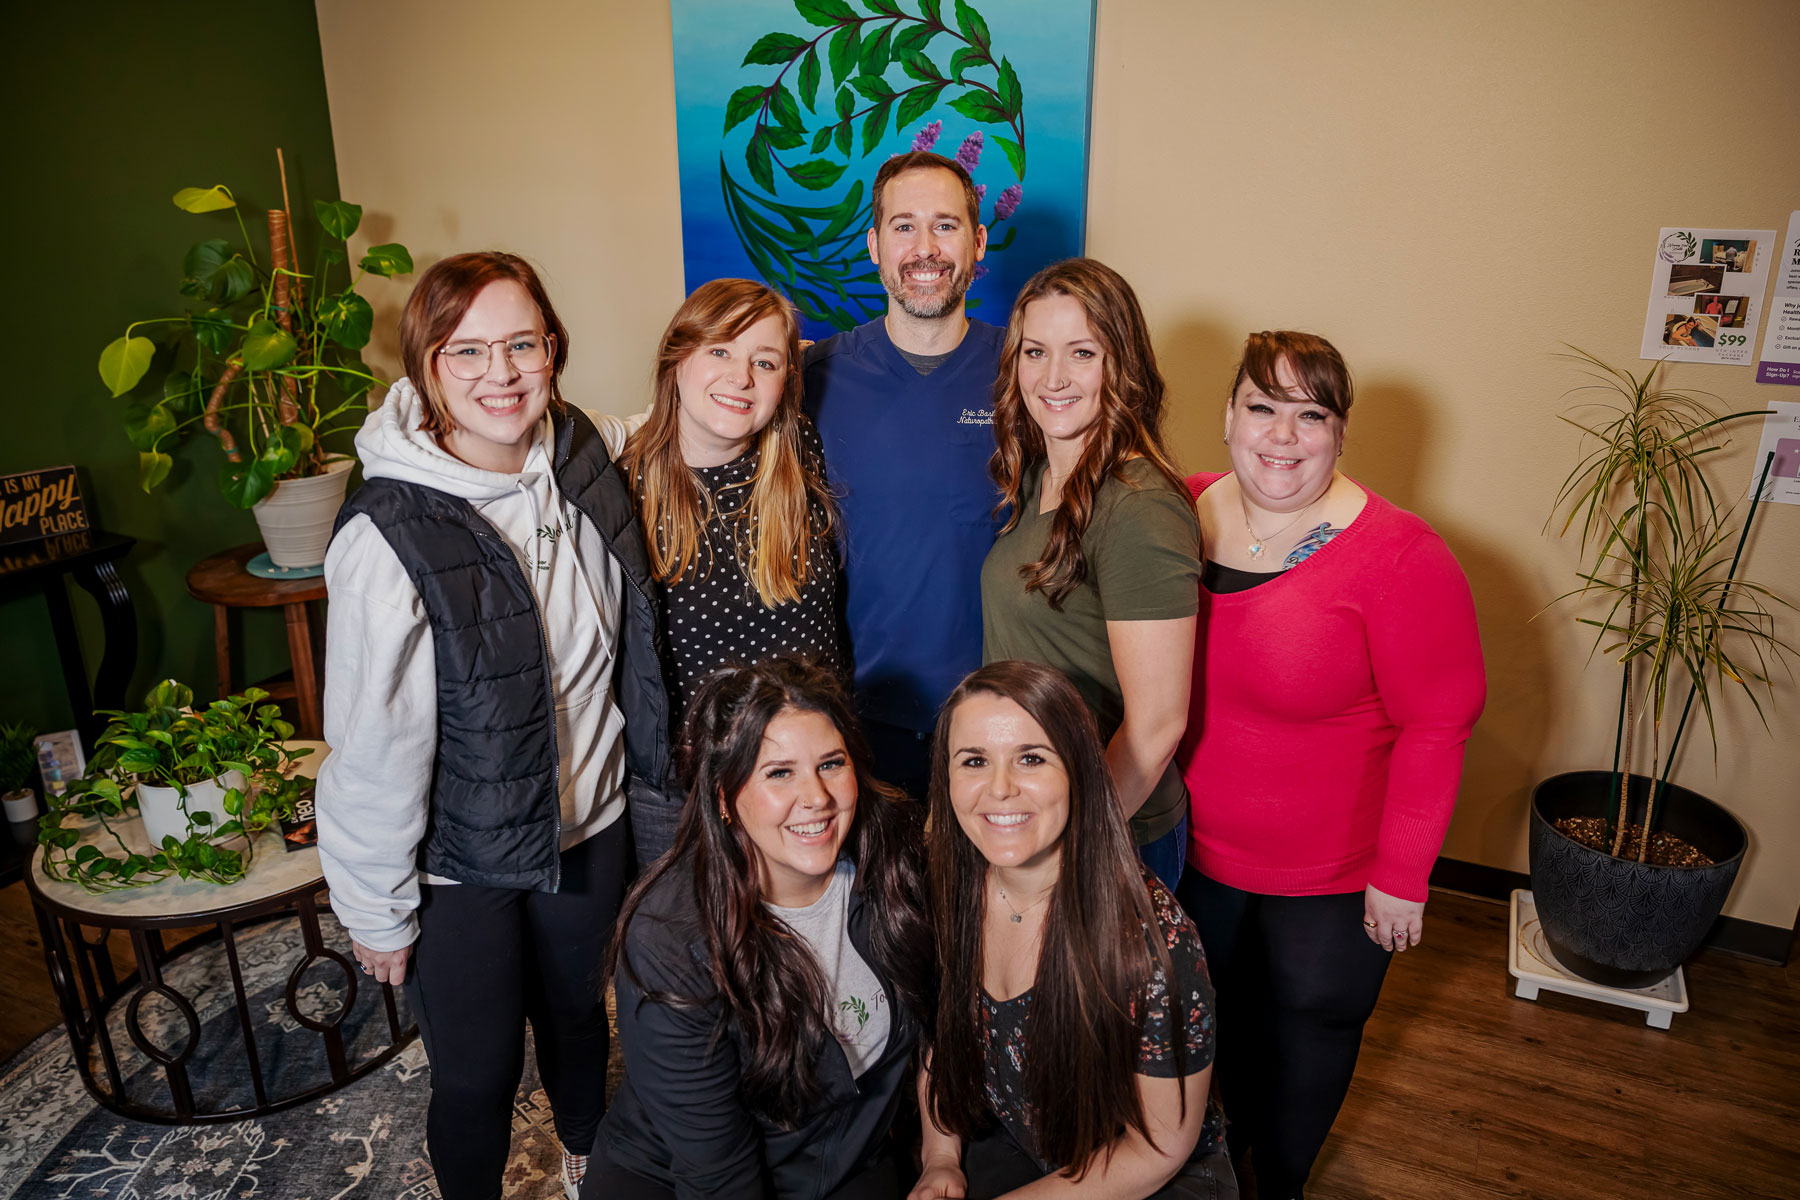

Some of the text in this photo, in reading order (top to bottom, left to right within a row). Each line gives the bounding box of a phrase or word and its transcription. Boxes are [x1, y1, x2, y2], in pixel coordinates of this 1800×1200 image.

[1718, 333, 1747, 347] $99
[961, 408, 976, 417] Eric
[4, 474, 41, 494] IS MY
[39, 510, 86, 536] PLACE
